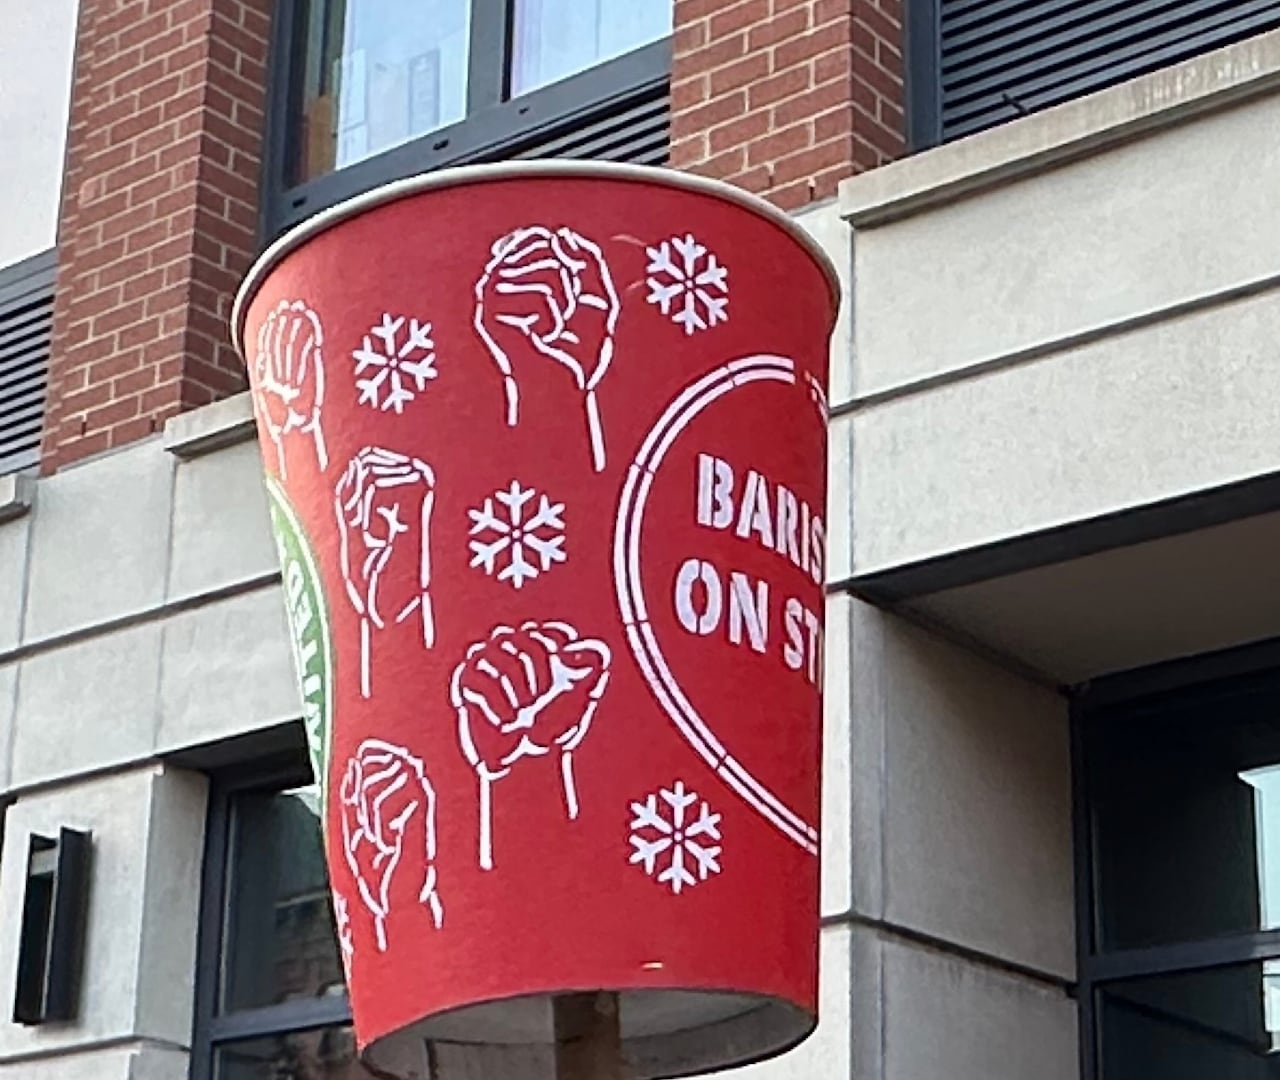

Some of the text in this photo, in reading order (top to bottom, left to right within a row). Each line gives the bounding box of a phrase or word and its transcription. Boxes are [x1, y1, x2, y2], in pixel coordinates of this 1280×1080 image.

[696, 453, 827, 585] BARIS
[675, 558, 820, 684] ON ST
